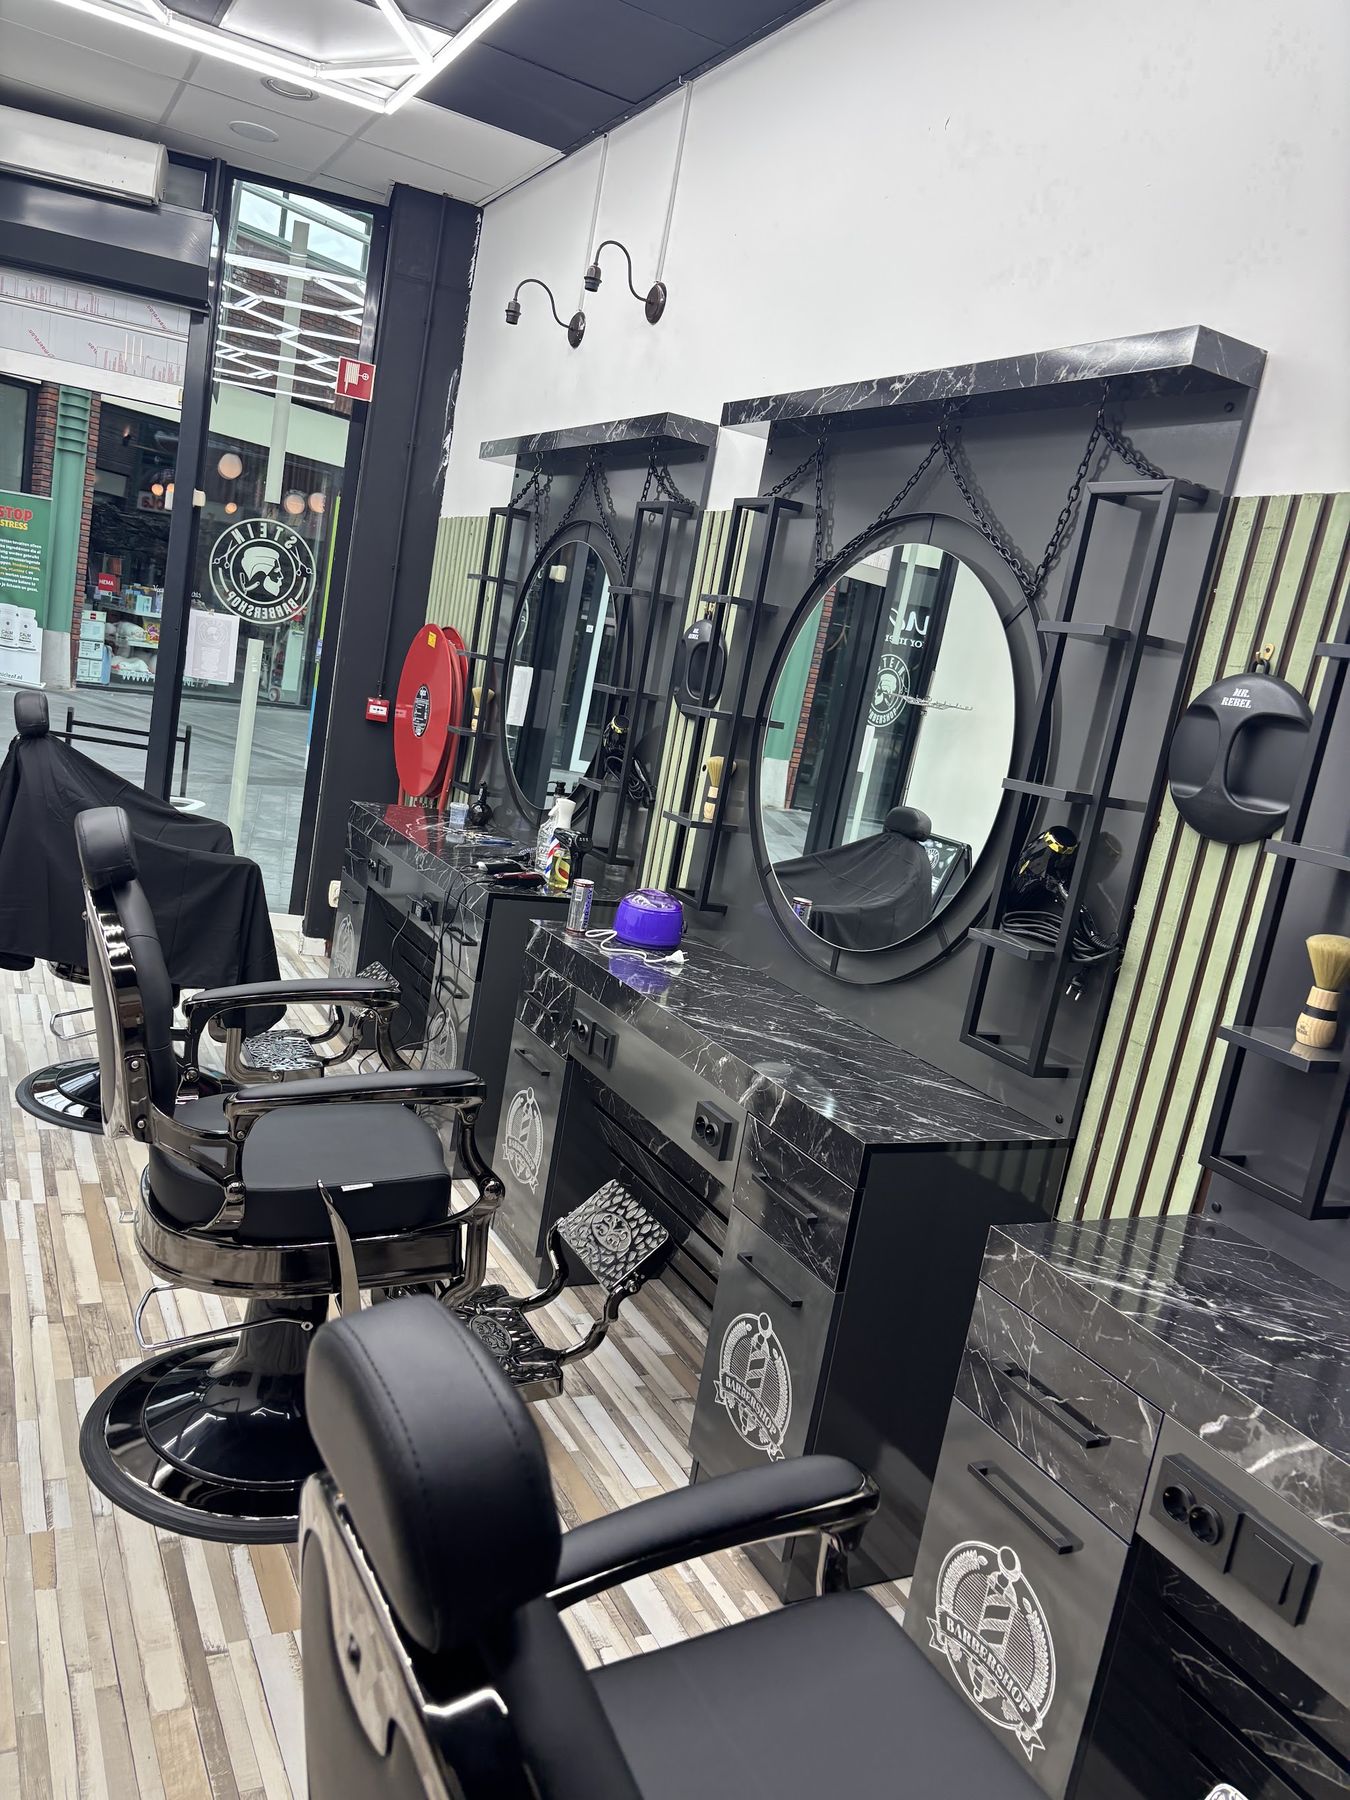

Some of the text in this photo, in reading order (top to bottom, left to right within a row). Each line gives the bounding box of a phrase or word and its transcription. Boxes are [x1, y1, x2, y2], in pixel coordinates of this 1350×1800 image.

[0, 519, 28, 531] STRESS
[878, 656, 906, 676] TEIN
[1232, 687, 1250, 698] MR.
[1221, 696, 1252, 709] REBEL
[868, 708, 897, 724] RBERSHOP
[725, 1376, 777, 1436] BARBERSHOP
[945, 1615, 1031, 1713] BARBERSHOP
